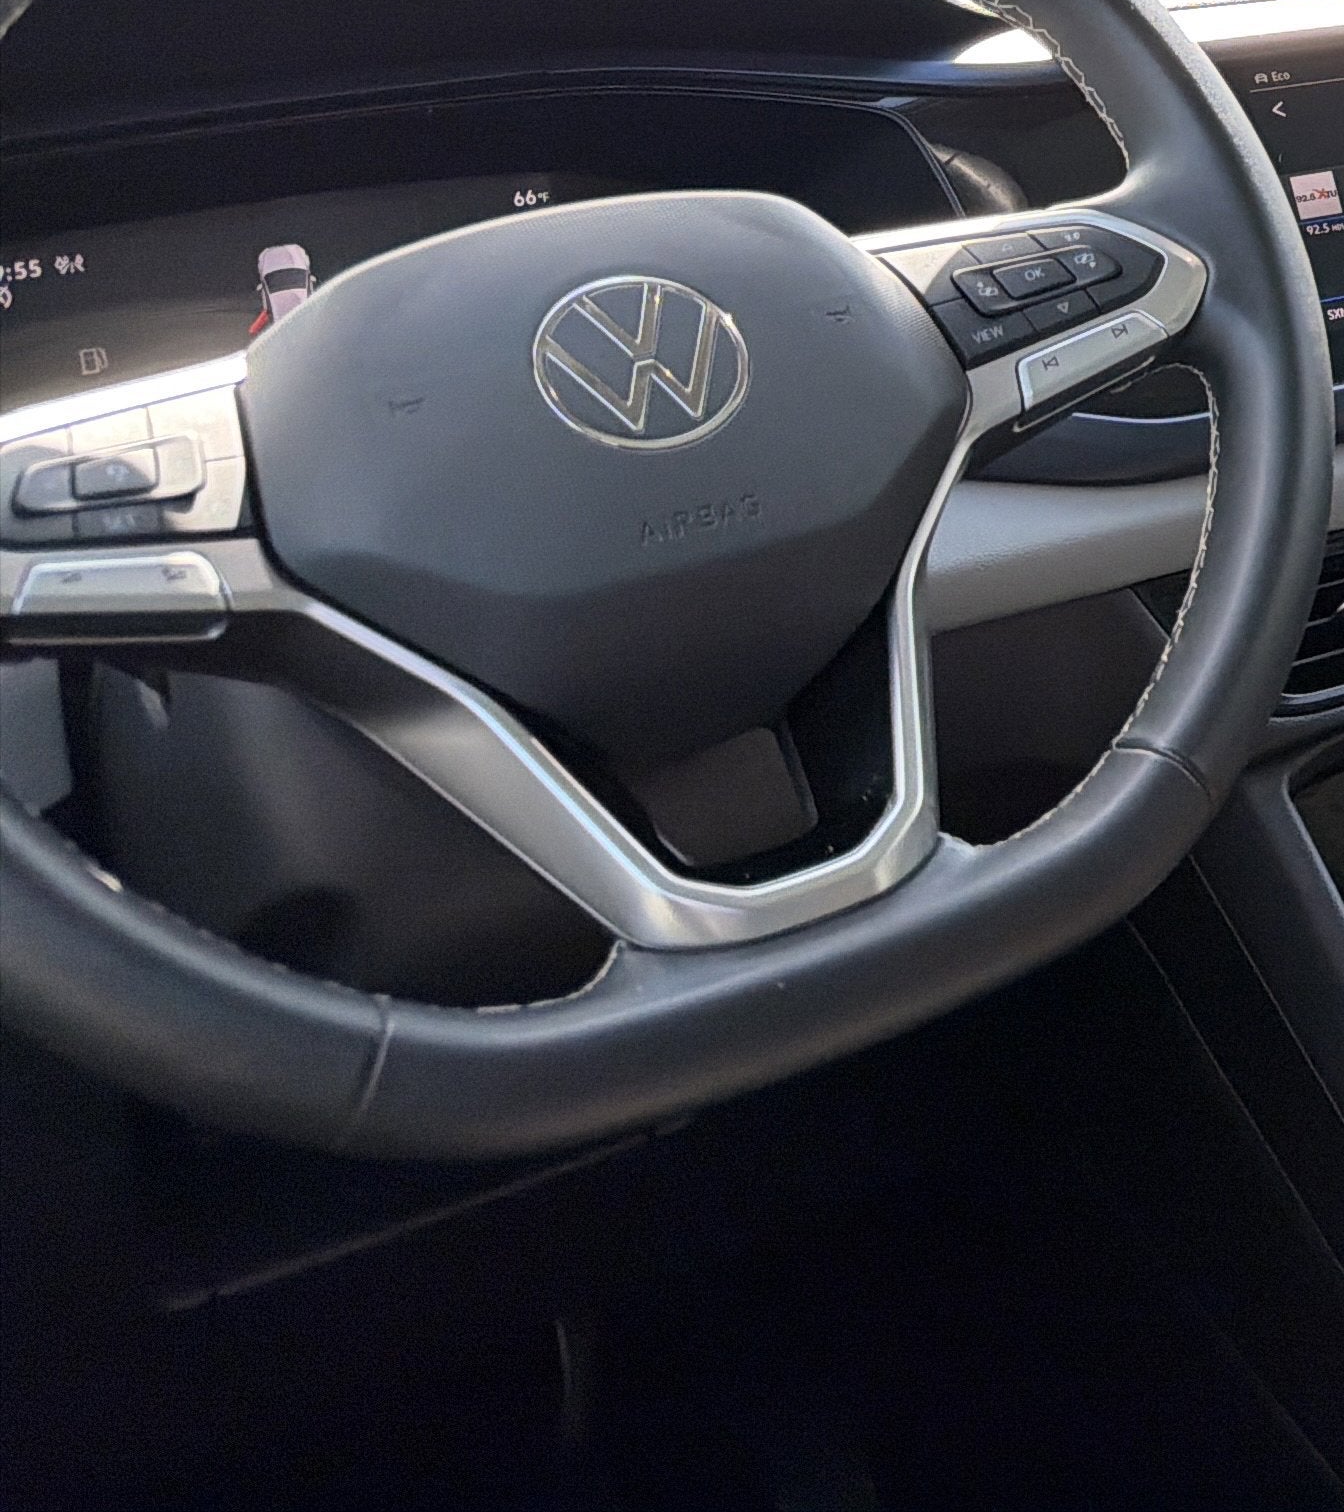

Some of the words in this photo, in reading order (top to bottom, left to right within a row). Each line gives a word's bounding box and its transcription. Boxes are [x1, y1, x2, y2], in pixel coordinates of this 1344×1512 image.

[1271, 71, 1290, 82] Eco
[513, 191, 550, 207] 66°F
[1306, 222, 1330, 235] 92.5
[1024, 268, 1045, 282] OK
[971, 326, 1004, 344] VIEW
